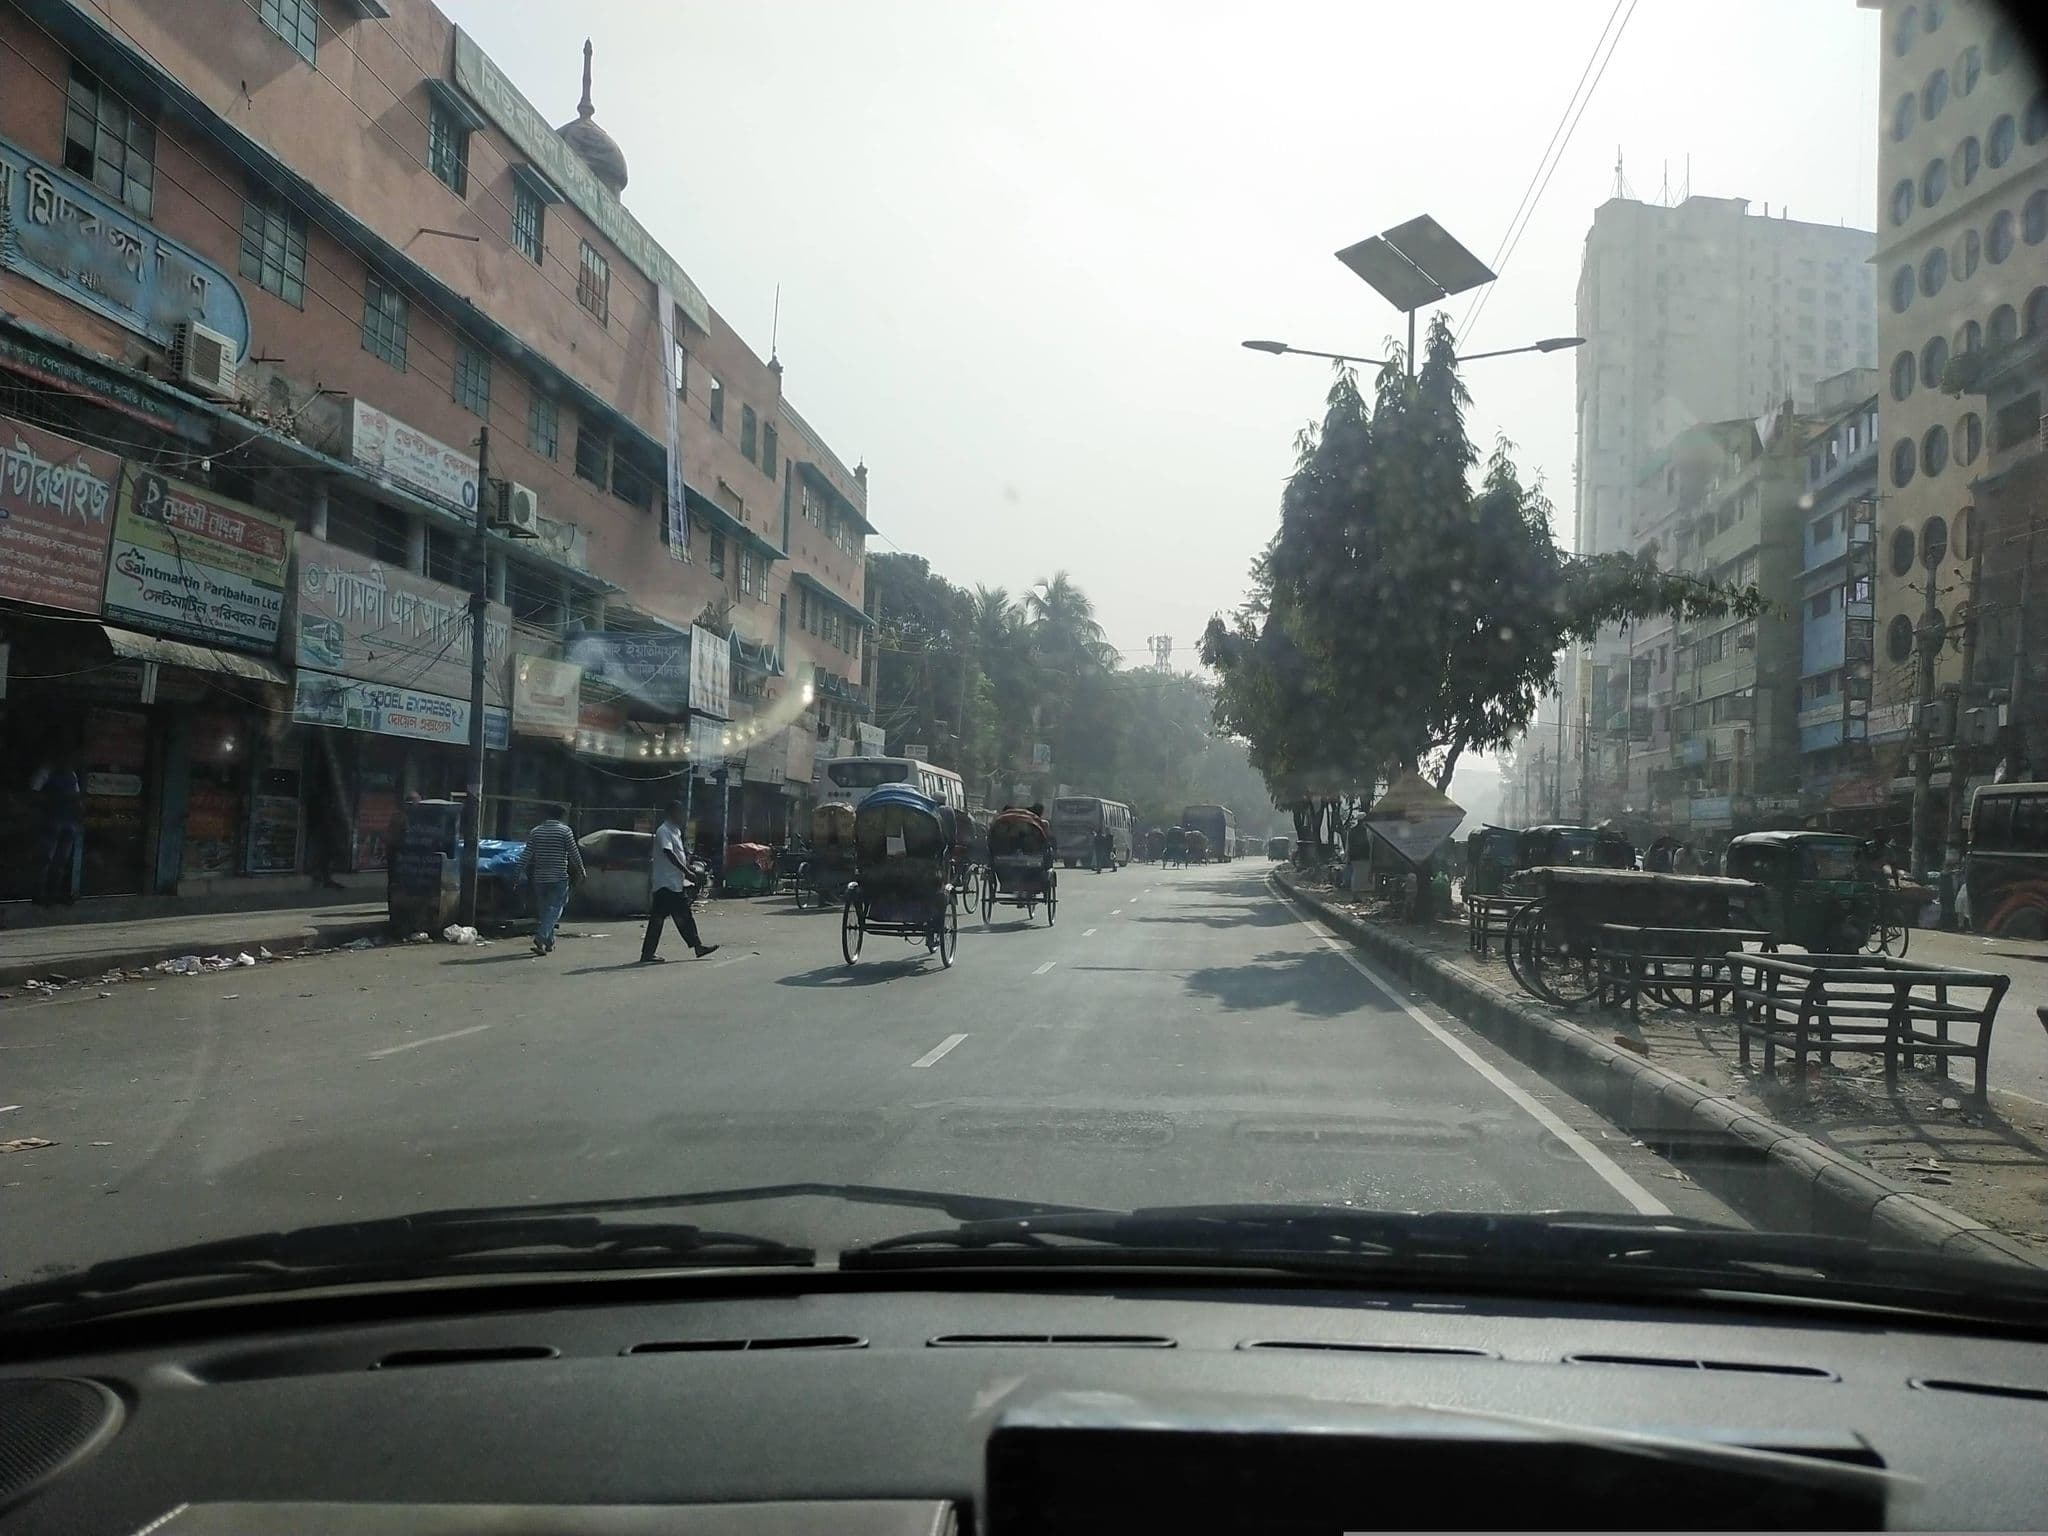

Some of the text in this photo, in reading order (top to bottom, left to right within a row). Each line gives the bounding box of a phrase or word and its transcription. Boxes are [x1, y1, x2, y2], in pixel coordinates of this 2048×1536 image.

[208, 511, 247, 543] বাংলা
[123, 559, 200, 591] Saintmartin
[204, 580, 260, 607] Paribahan
[262, 594, 280, 612] Ltd.
[324, 562, 387, 631] শ্যামলী
[143, 588, 207, 615] সেন্টমার্টিন
[211, 602, 256, 627] পরিবহন
[406, 695, 452, 717] EXPRESS
